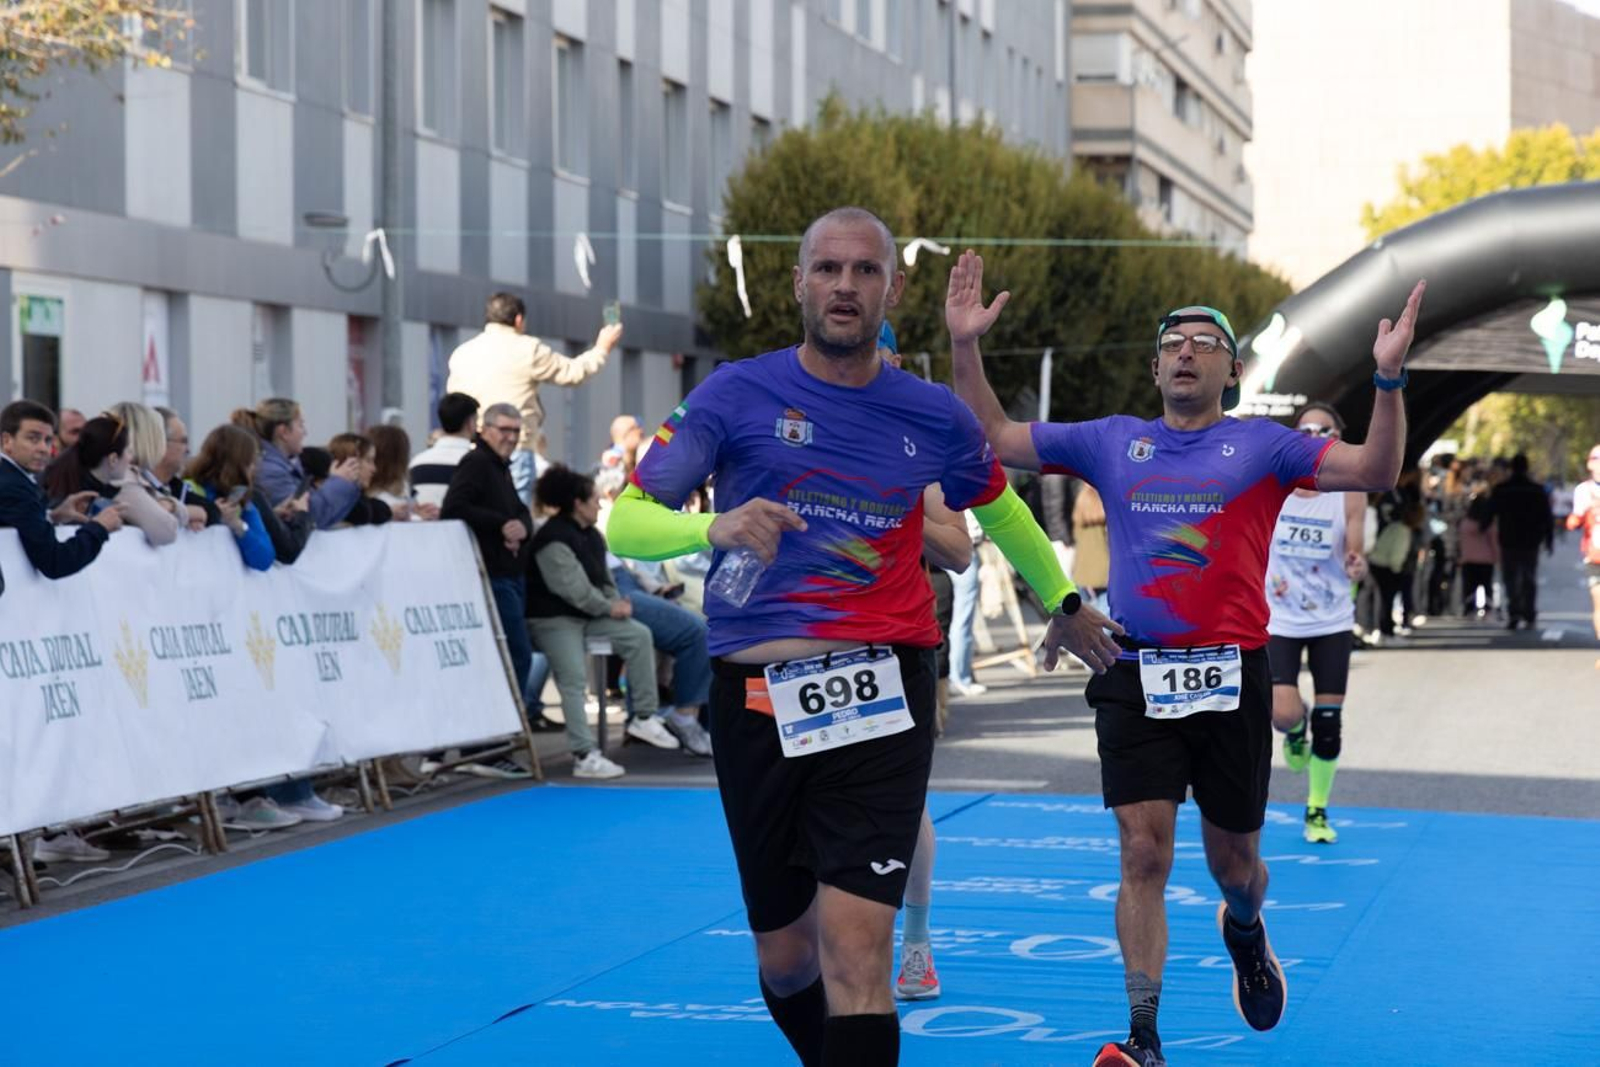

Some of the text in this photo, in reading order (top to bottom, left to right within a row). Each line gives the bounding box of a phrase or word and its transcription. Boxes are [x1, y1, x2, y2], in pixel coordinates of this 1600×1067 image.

[787, 488, 848, 507] ATLETISMO
[1131, 491, 1176, 503] ATLETISMO
[1131, 502, 1226, 514] MANCHA REAL
[786, 501, 904, 529] MANCHA REAL
[1289, 527, 1323, 544] 763
[313, 610, 360, 643] RURAL
[436, 602, 483, 631] RURAL
[181, 622, 232, 659] RURAL
[0, 632, 102, 680] CAJA RURAL
[180, 660, 218, 702] JAÉN
[798, 669, 879, 715] 698
[1162, 666, 1223, 692] 186
[40, 675, 81, 725] JAÉN
[831, 707, 859, 721] PEDRO
